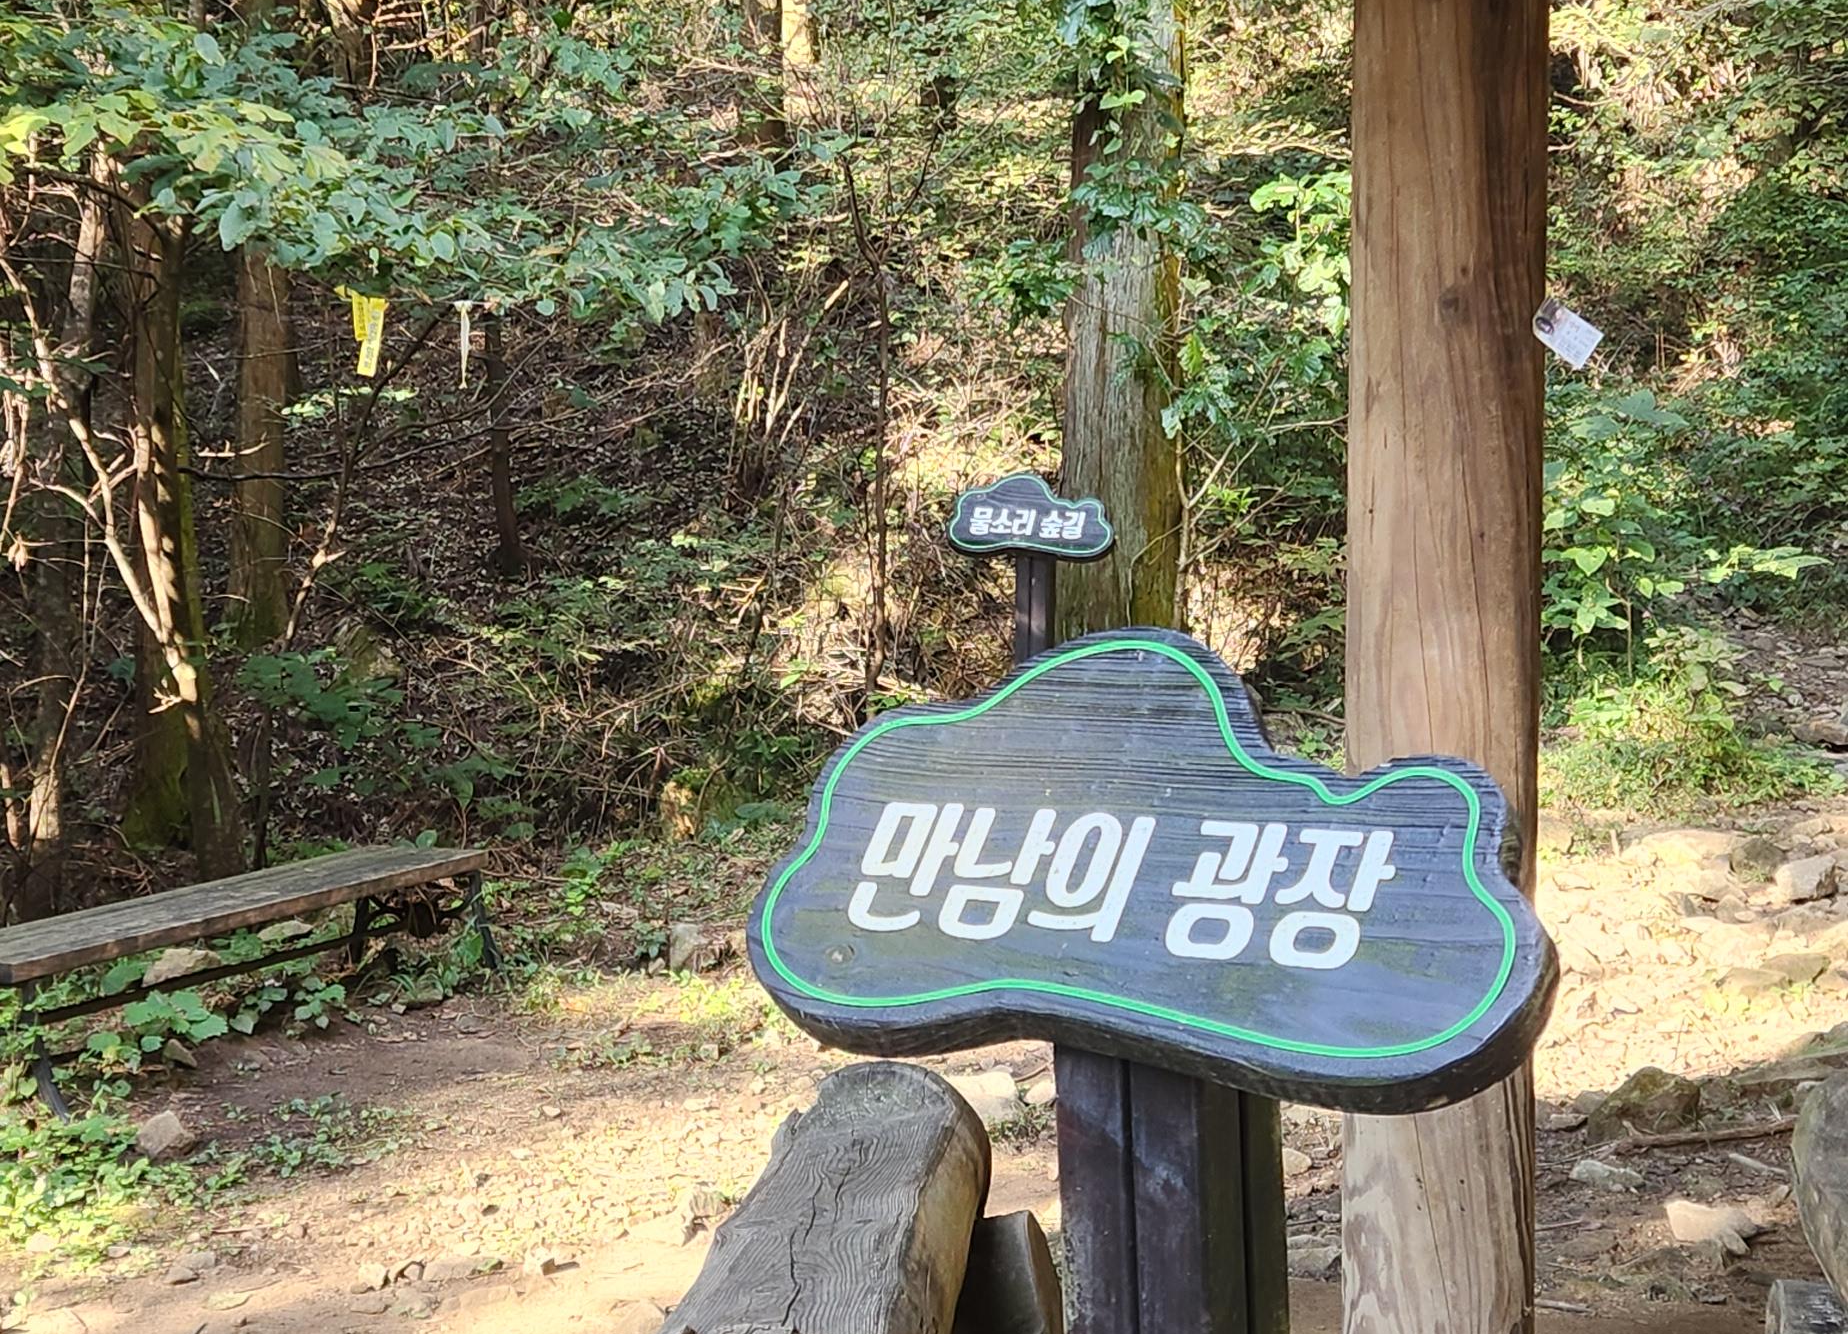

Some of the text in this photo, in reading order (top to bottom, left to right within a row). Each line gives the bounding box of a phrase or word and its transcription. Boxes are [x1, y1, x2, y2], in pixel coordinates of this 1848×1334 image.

[968, 506, 1087, 541] 물소리 숲길
[846, 800, 1397, 971] 만남의 광장
